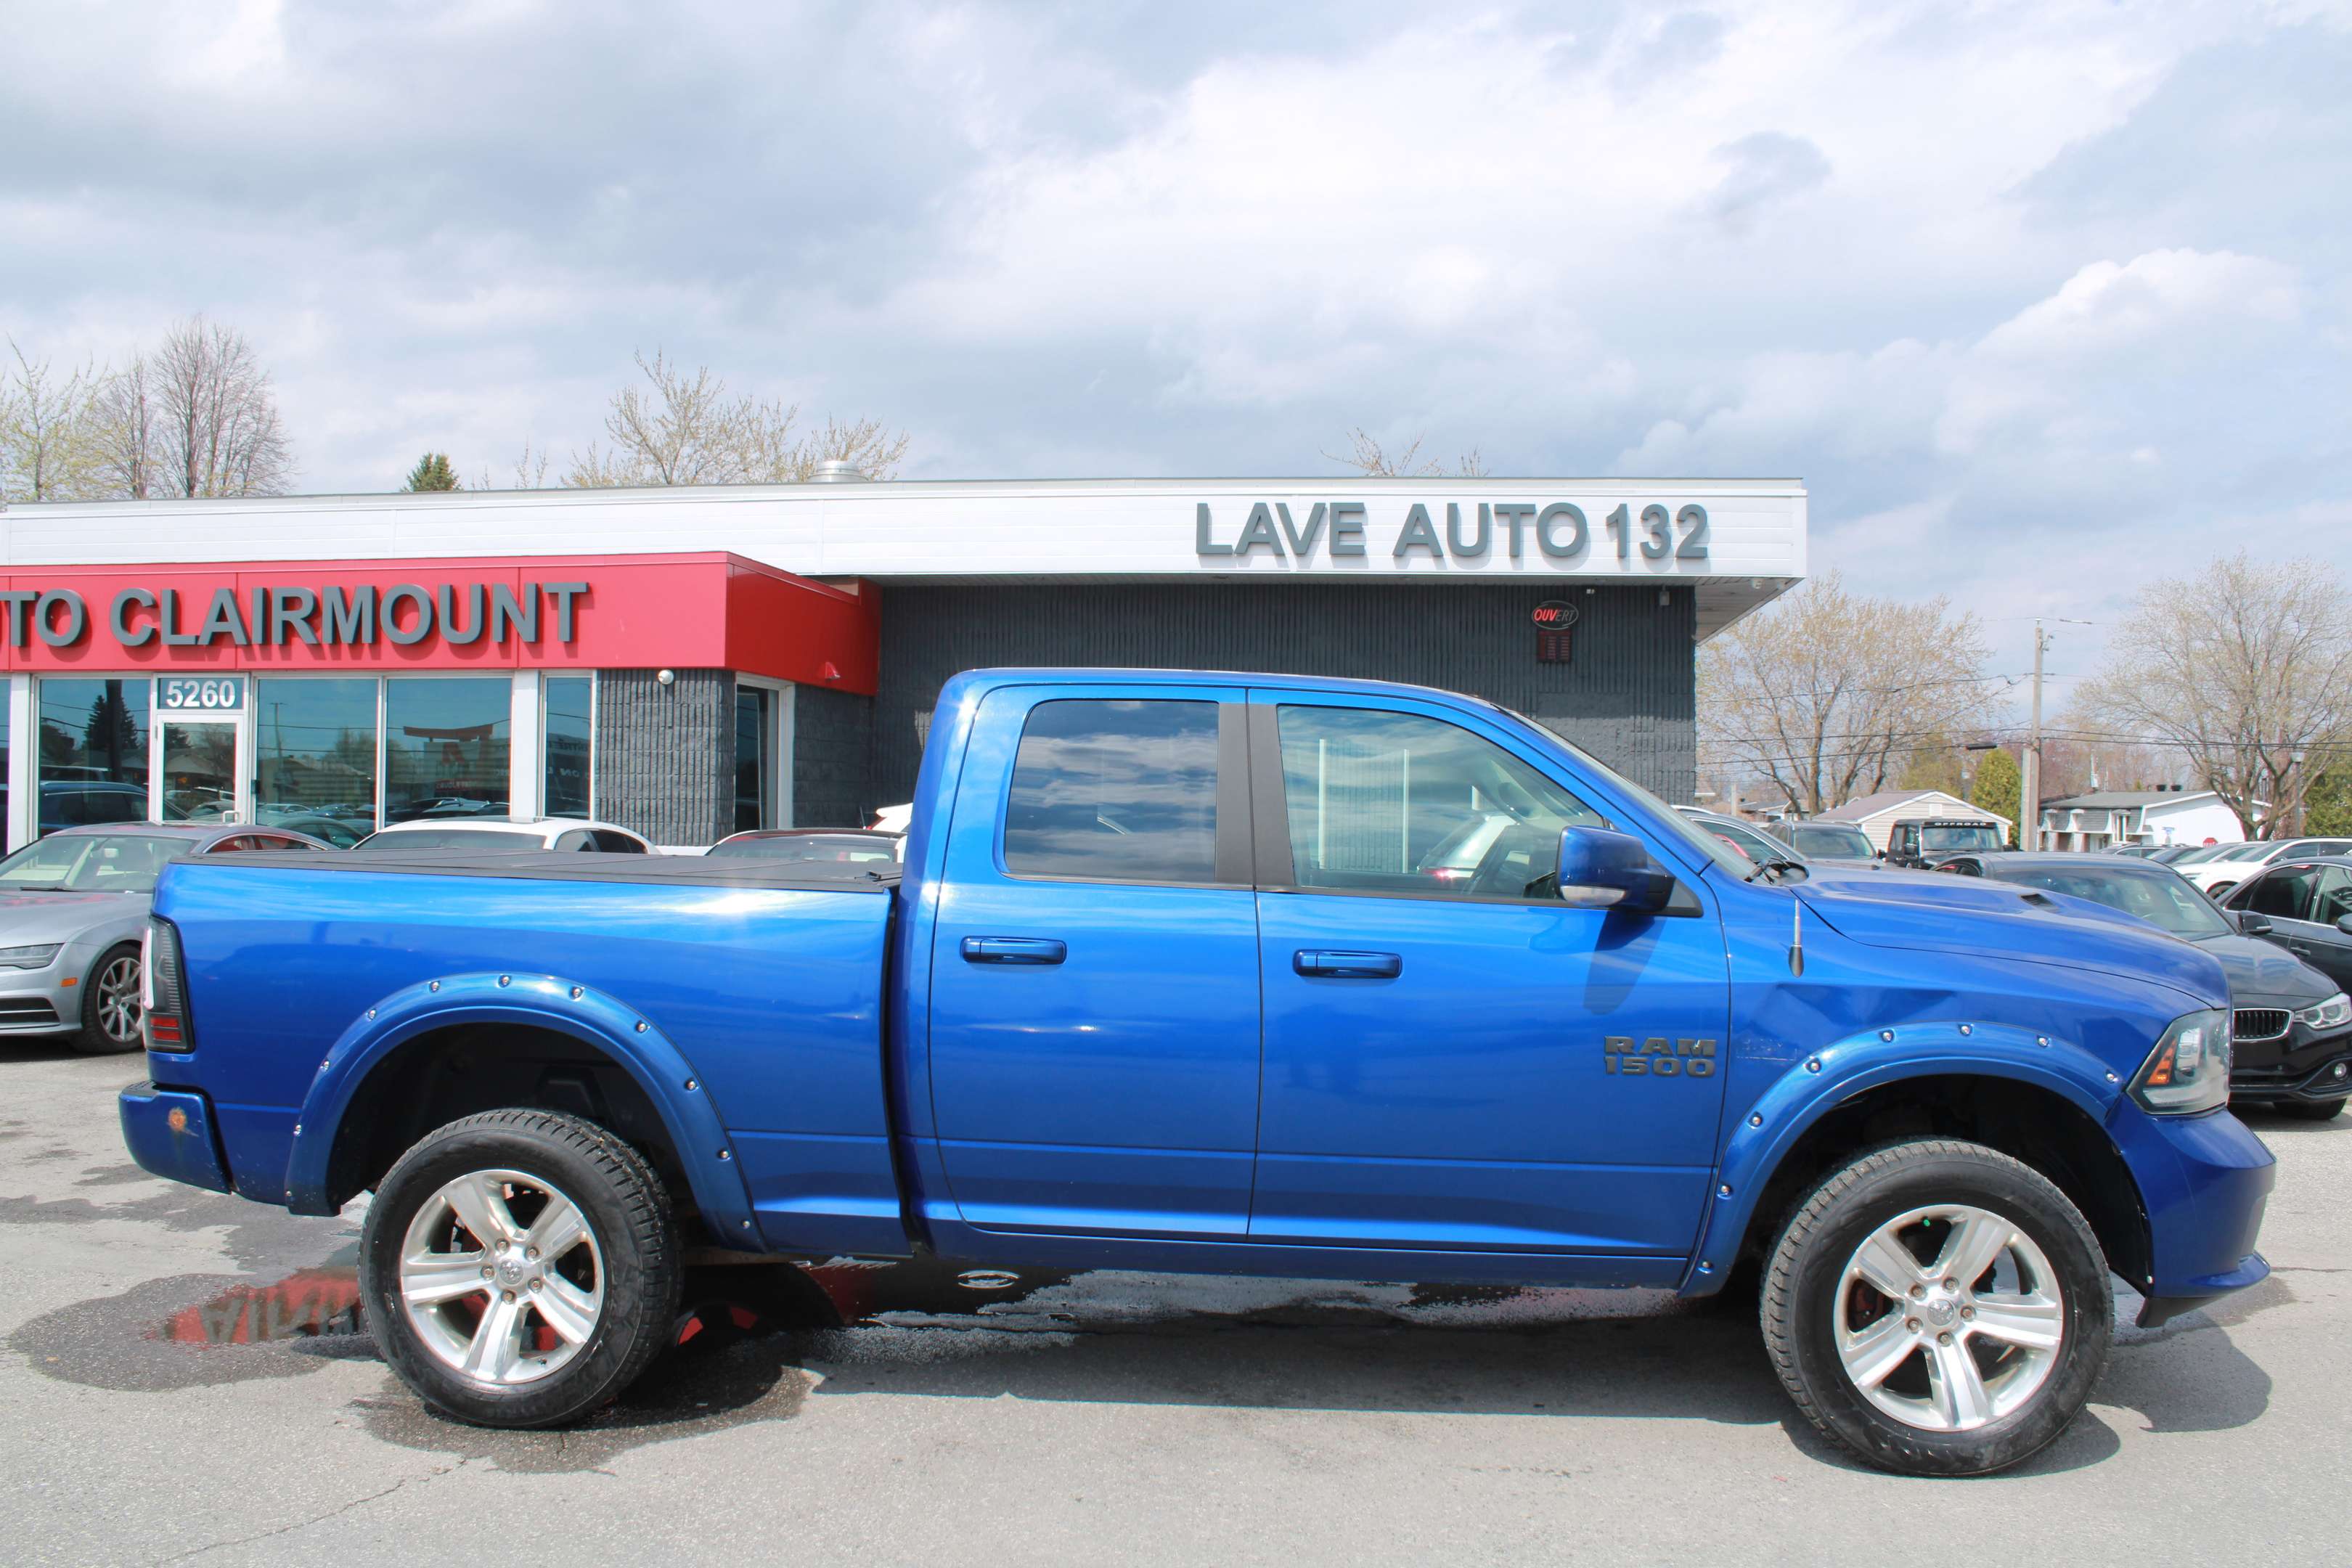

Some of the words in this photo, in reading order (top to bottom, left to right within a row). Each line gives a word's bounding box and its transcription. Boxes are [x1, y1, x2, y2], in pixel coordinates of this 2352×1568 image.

[1196, 502, 1366, 557] LAVE
[1392, 502, 1588, 558] AUTO
[1605, 503, 1709, 559] 132
[0, 588, 86, 648] TO
[110, 581, 590, 648] CLAIRMOUNT
[1534, 608, 1575, 621] OUVERT
[166, 679, 236, 709] 5260
[1604, 1035, 1717, 1057] RAM
[1604, 1056, 1716, 1077] 1500
